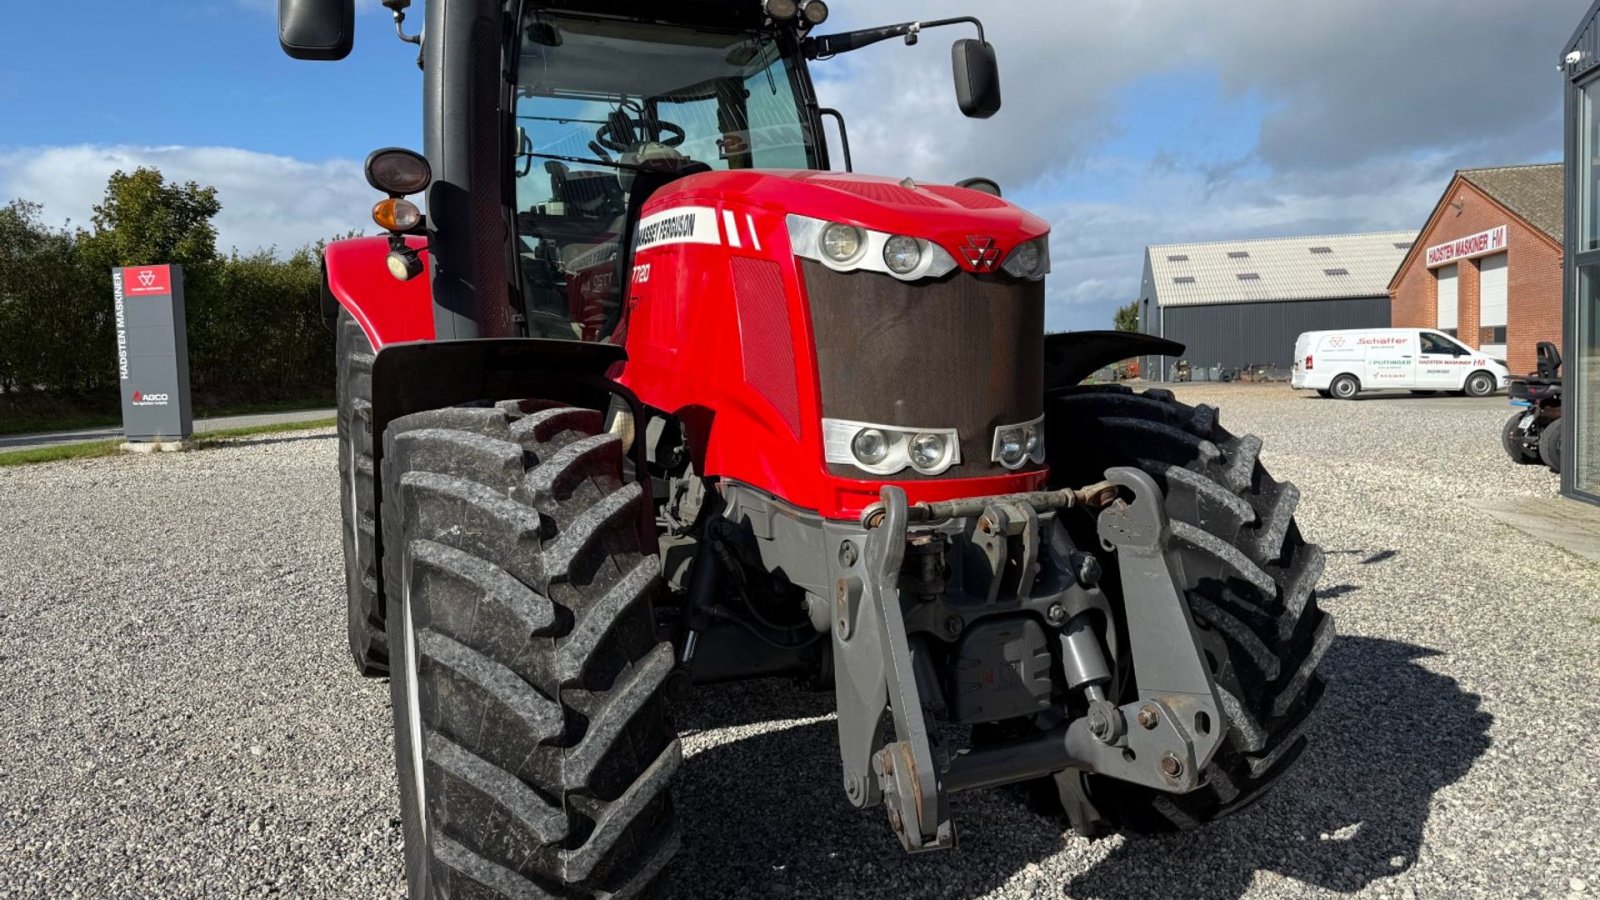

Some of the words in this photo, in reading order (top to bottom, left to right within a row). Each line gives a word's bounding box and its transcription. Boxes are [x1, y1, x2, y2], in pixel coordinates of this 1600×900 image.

[660, 213, 695, 239] FERGUSON
[1428, 244, 1454, 264] HADSTEN
[1455, 233, 1489, 258] MASKINER
[1492, 228, 1503, 249] HM
[632, 263, 650, 283] 7720
[114, 273, 125, 327] MASKINER
[118, 330, 128, 379] HADSTEN
